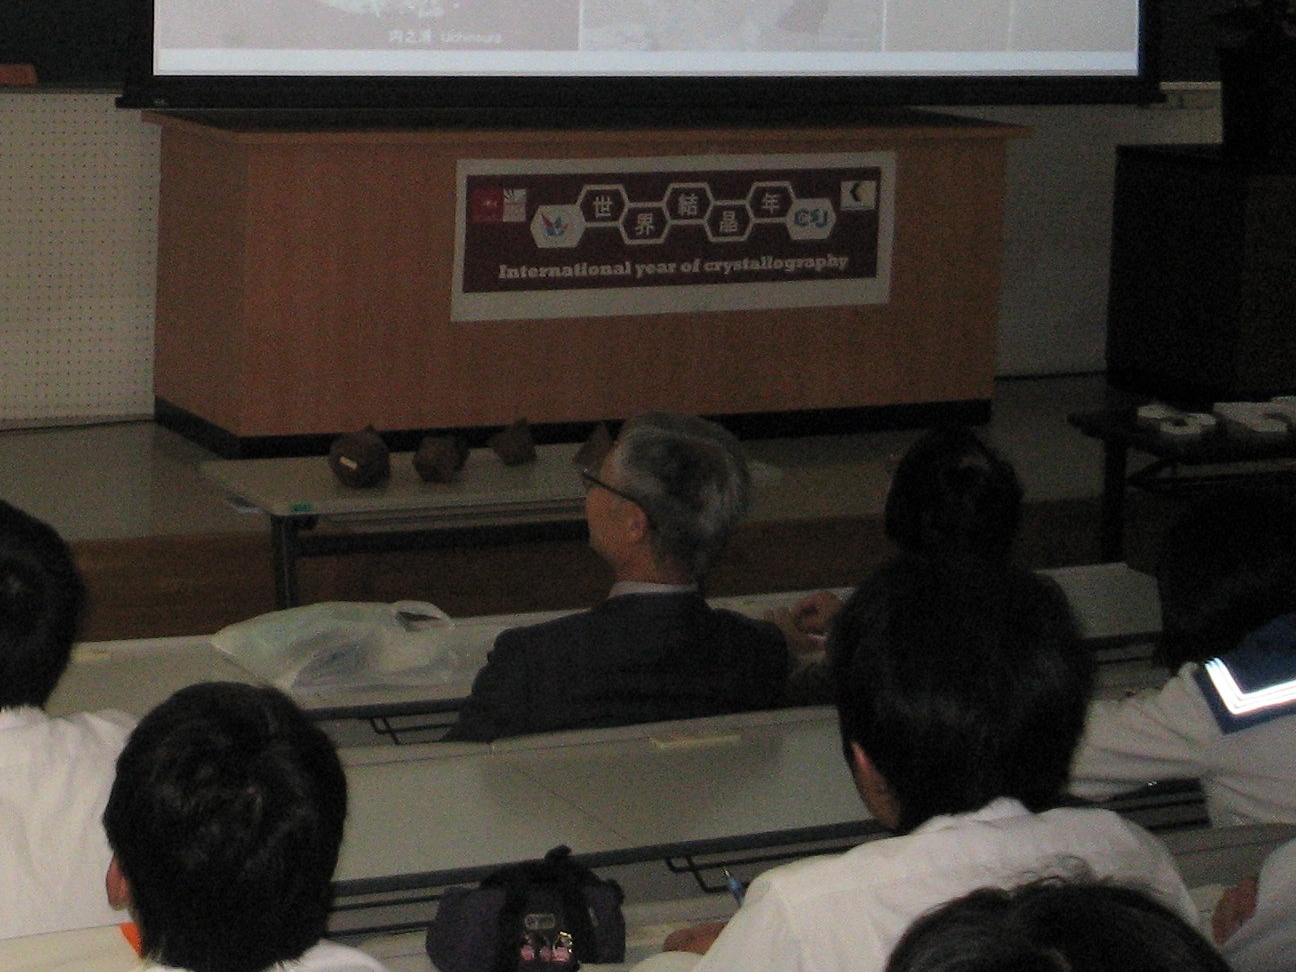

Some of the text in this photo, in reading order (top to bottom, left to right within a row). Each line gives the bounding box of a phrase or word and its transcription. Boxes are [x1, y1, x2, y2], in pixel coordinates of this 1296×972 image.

[499, 254, 850, 280] International year of crystallography
